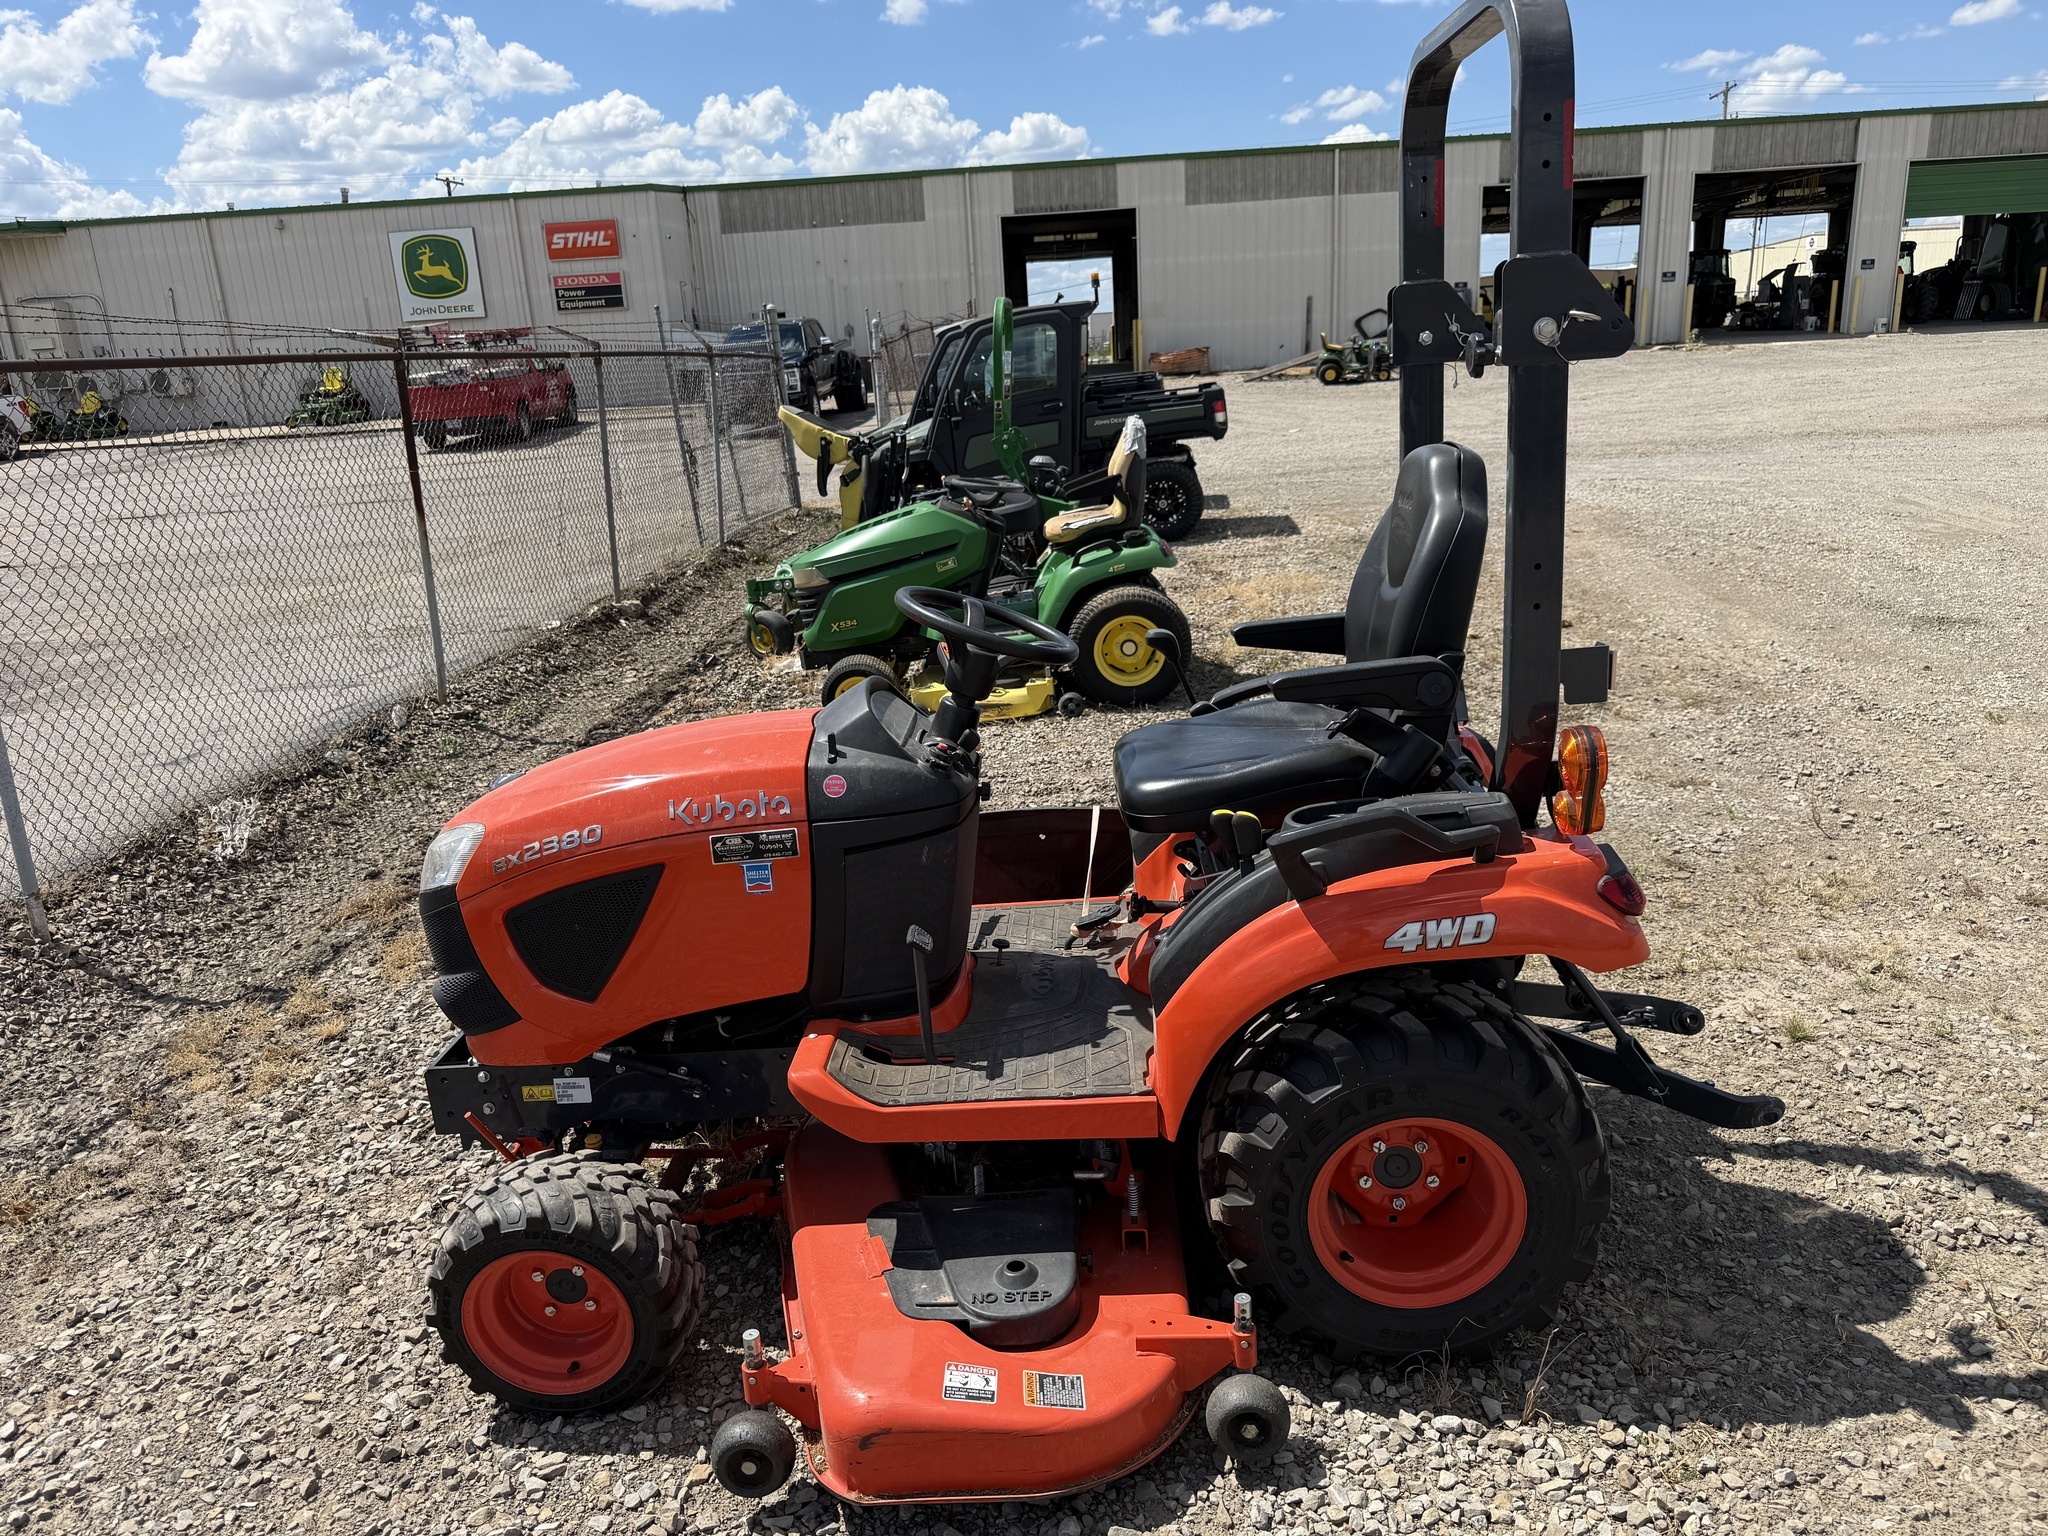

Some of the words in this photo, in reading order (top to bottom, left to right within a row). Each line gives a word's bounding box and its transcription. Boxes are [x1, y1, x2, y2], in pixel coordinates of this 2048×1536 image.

[551, 230, 611, 250] STIHL
[557, 275, 610, 286] HONDA
[410, 306, 437, 316] JOHN
[438, 304, 474, 314] DEERE
[560, 299, 606, 309] Equipment
[830, 619, 858, 632] X534
[668, 790, 790, 825] Kubota
[492, 824, 602, 875] BX2380
[1383, 912, 1498, 954] 4WD
[972, 1292, 998, 1304] NO
[1004, 1290, 1052, 1303] STEP
[958, 1364, 994, 1376] DANGER
[1026, 1372, 1035, 1398] WARNING
